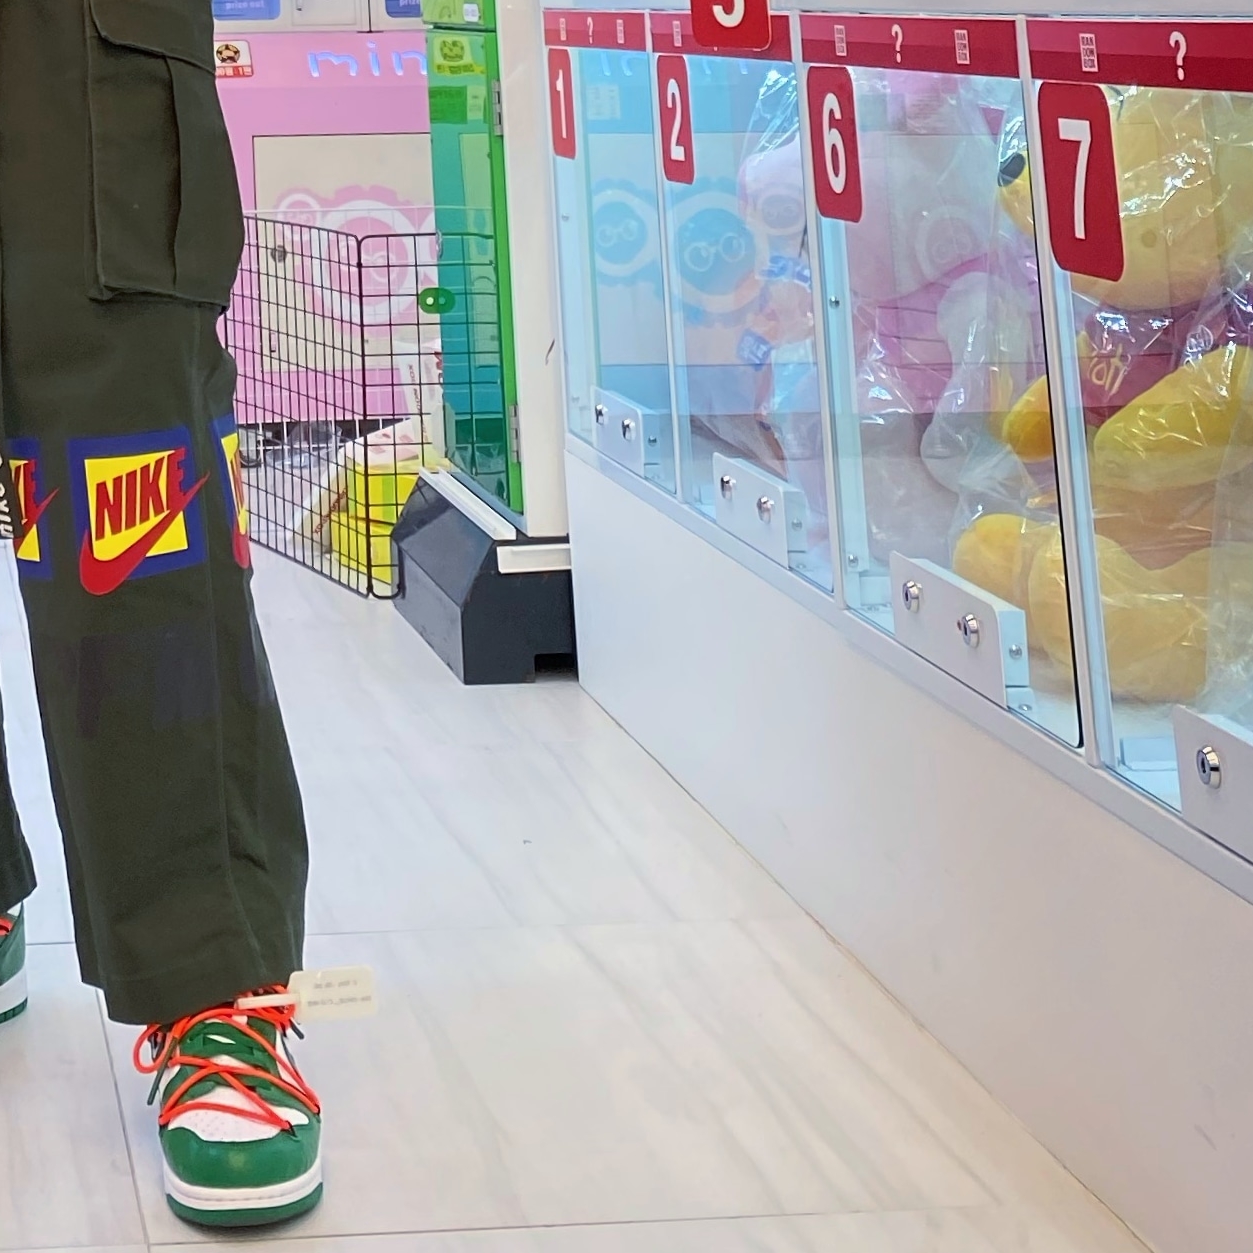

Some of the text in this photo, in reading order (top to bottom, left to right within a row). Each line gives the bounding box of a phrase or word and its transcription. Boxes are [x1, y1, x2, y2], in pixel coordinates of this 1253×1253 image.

[225, 1, 248, 11] prize
[308, 41, 427, 78] min
[556, 69, 567, 139] 1
[667, 78, 686, 162] 2
[822, 92, 846, 194] 6
[1057, 117, 1091, 240] 7
[95, 446, 186, 542] NIKE
